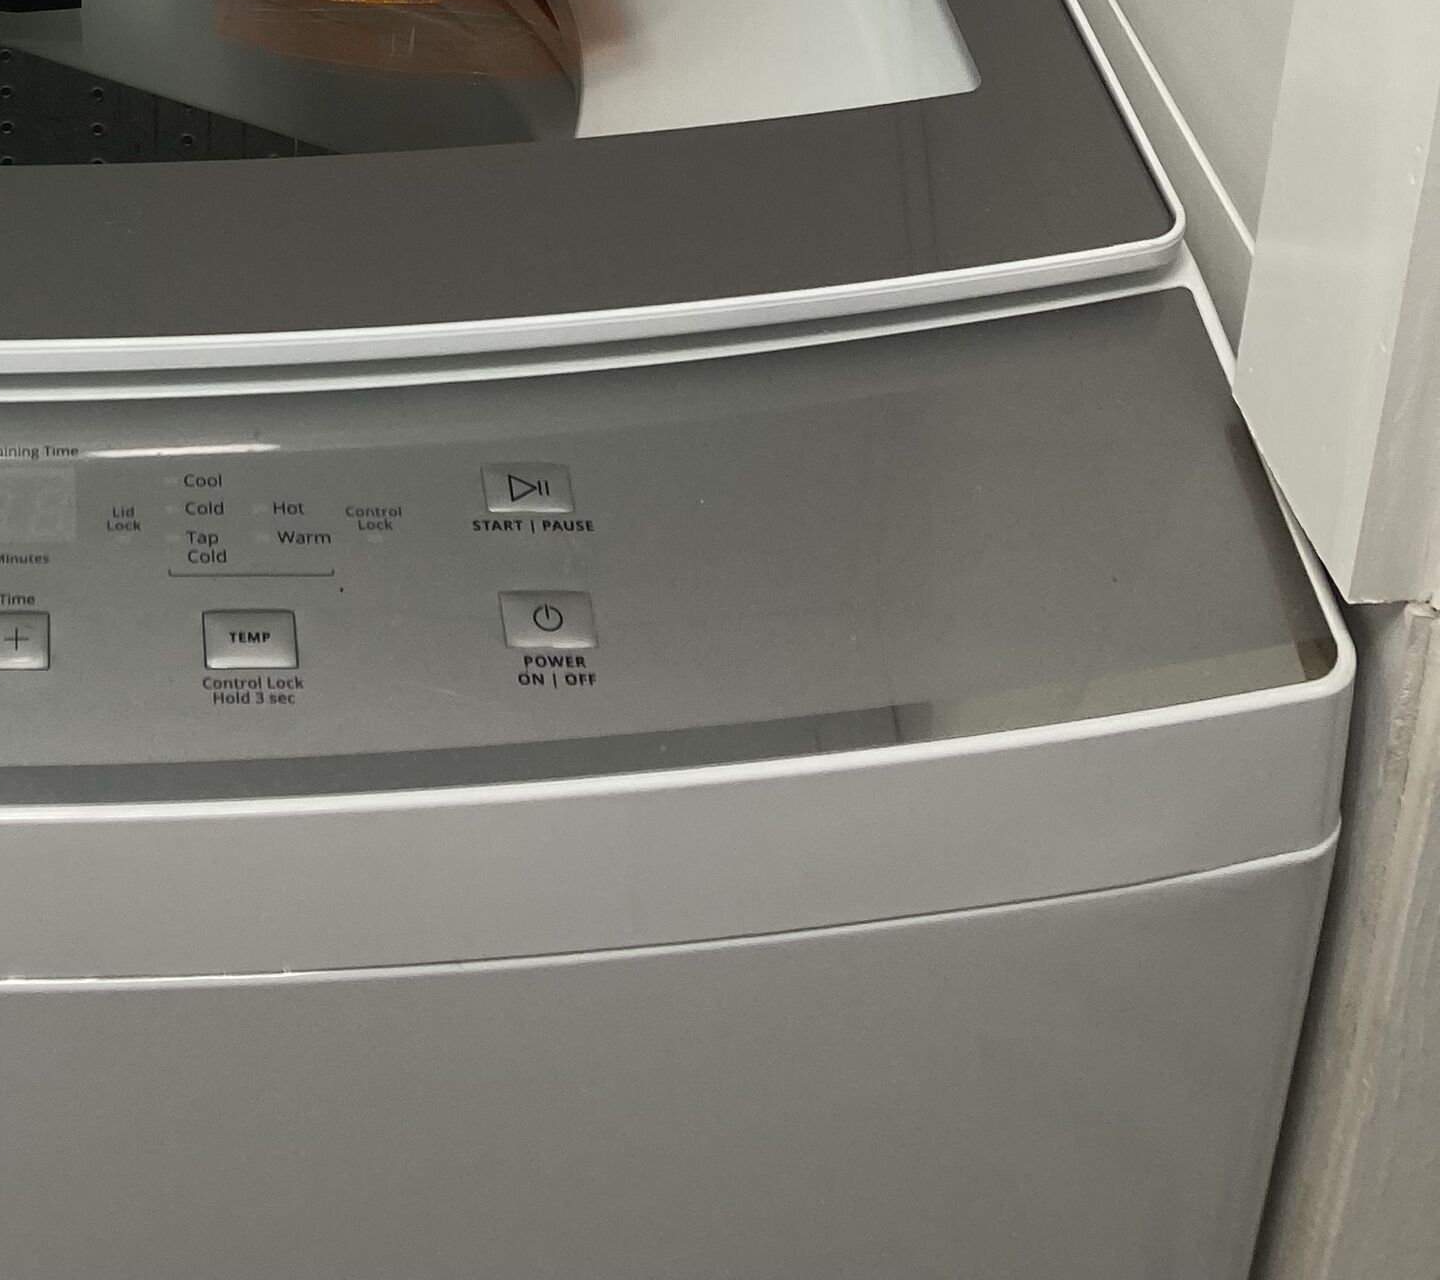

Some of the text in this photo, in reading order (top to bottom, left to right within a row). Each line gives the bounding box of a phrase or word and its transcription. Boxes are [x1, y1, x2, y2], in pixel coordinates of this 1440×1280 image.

[43, 445, 79, 458] Time
[183, 473, 222, 488] Cool
[112, 506, 135, 518] Lid
[185, 501, 224, 516] Cold
[273, 501, 305, 516] Hot
[346, 506, 402, 518] Control
[106, 520, 142, 532] Lock
[357, 519, 394, 531] Lock
[472, 519, 594, 532] START PAUSE
[186, 530, 219, 547] Tap
[276, 530, 332, 545] Warm
[187, 549, 227, 564] Cold
[228, 630, 271, 644] TEMP
[523, 655, 587, 669] POWER
[202, 675, 304, 690] Control Lock
[517, 673, 597, 687] ON OFF
[212, 690, 296, 705] Hold 3 sec
